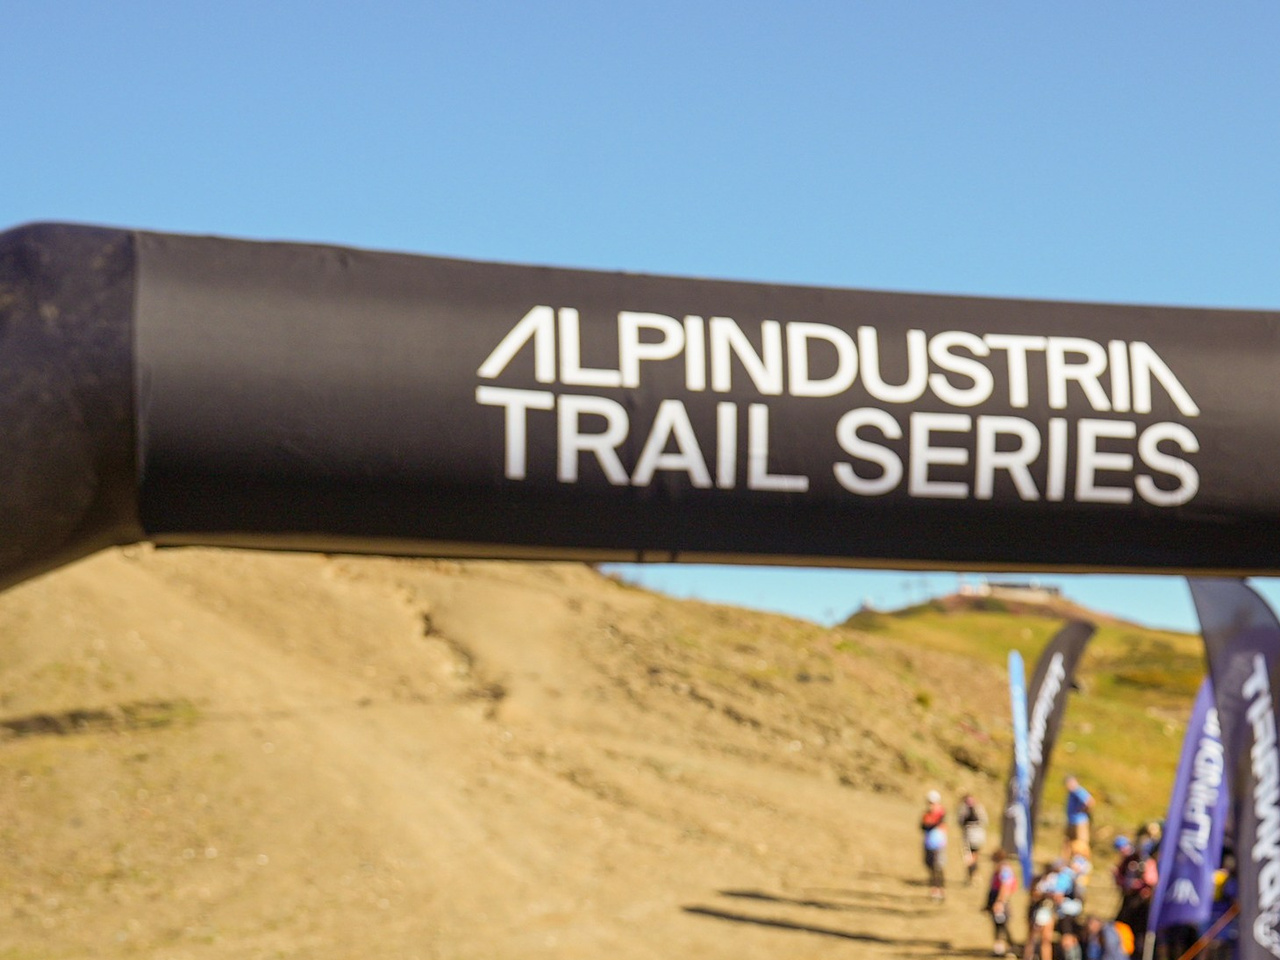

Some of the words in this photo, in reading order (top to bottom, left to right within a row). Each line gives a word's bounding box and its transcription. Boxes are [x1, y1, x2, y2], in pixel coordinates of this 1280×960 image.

[475, 305, 1201, 418] ALPINDUSTRIA
[475, 385, 810, 494] TRAIL
[832, 407, 1201, 508] SERIES
